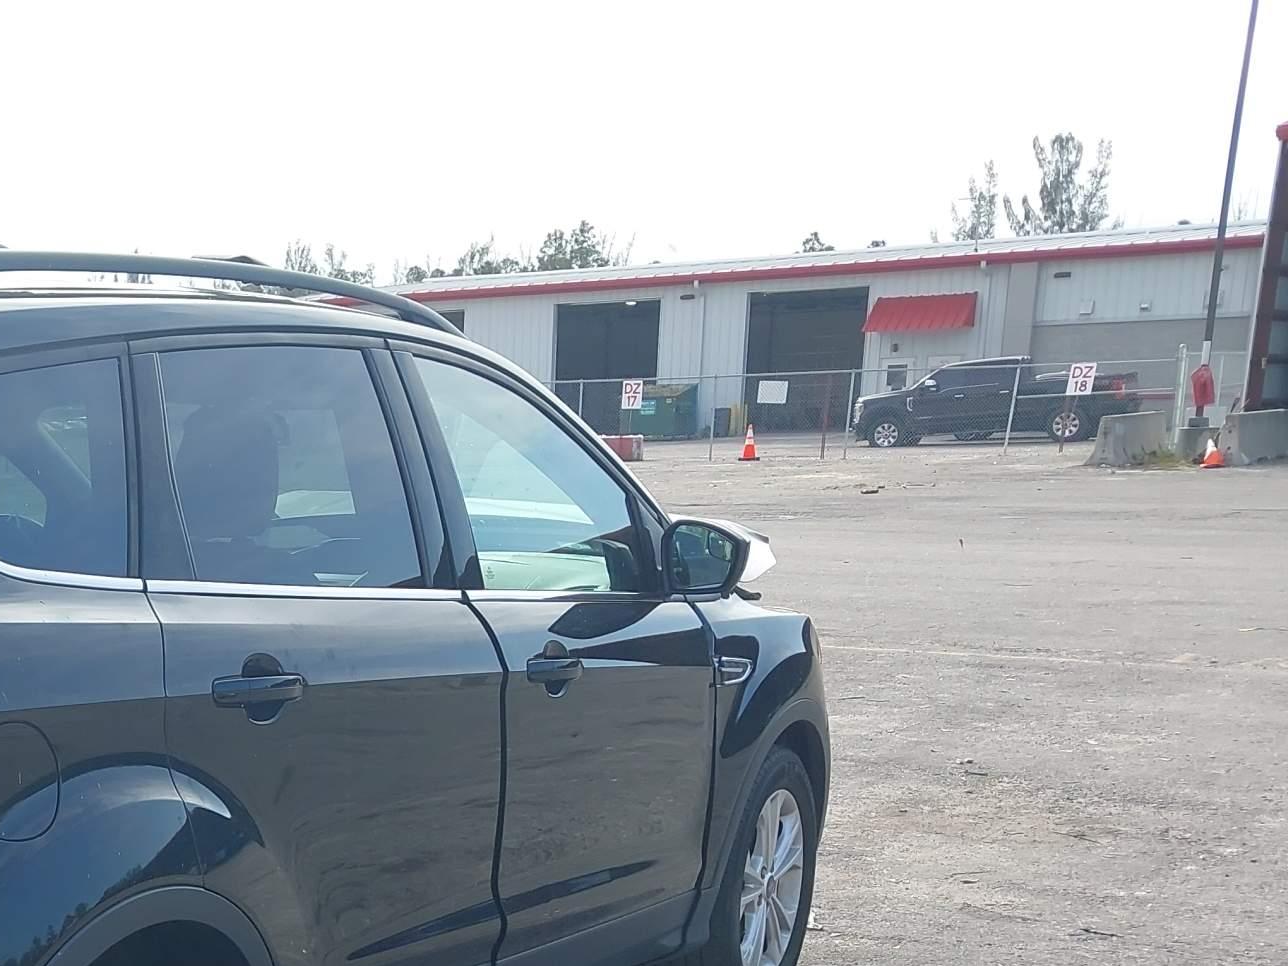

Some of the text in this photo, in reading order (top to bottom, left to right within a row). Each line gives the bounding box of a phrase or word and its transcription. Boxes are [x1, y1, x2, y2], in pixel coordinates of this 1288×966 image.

[1072, 366, 1094, 379] DZ
[624, 383, 641, 394] DZ
[1074, 380, 1088, 393] 18
[627, 395, 637, 407] 17
